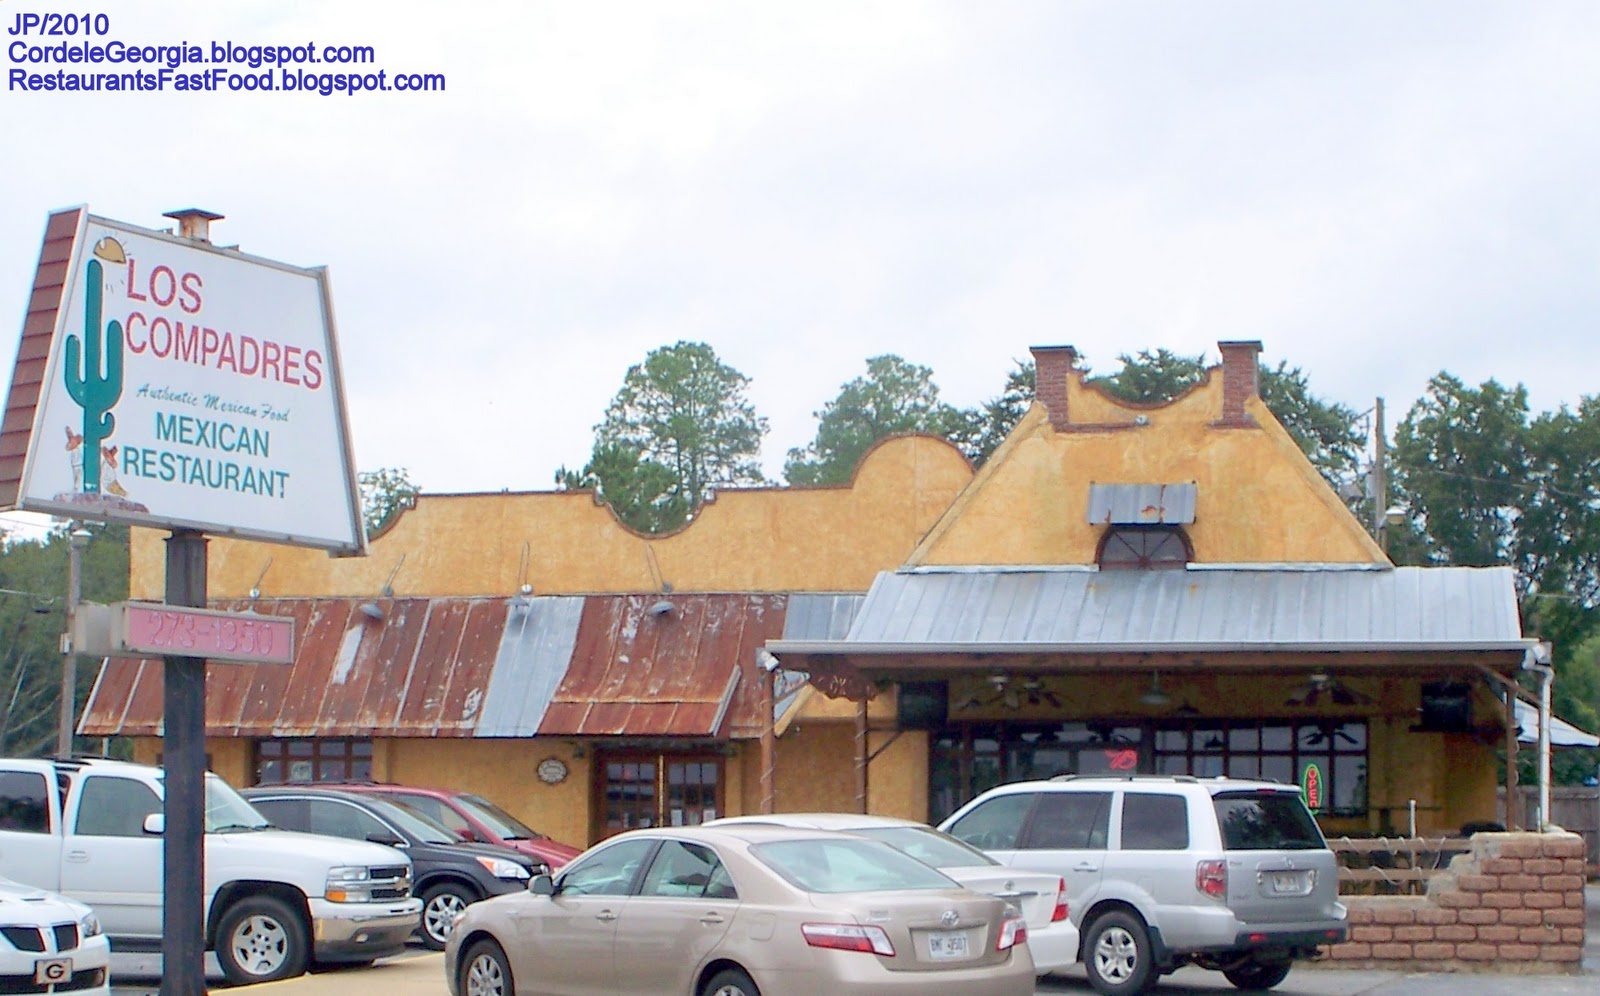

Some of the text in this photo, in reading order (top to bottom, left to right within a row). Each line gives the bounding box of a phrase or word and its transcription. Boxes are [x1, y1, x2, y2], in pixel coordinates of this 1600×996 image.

[126, 258, 203, 314] LOS
[126, 311, 323, 390] COMPADRES
[136, 383, 291, 422] Authentic Mexican Food
[156, 411, 270, 458] MEXICAN
[122, 445, 290, 499] RESTAURANT
[148, 612, 273, 656] 273-1350
[1308, 767, 1318, 808] OPEN
